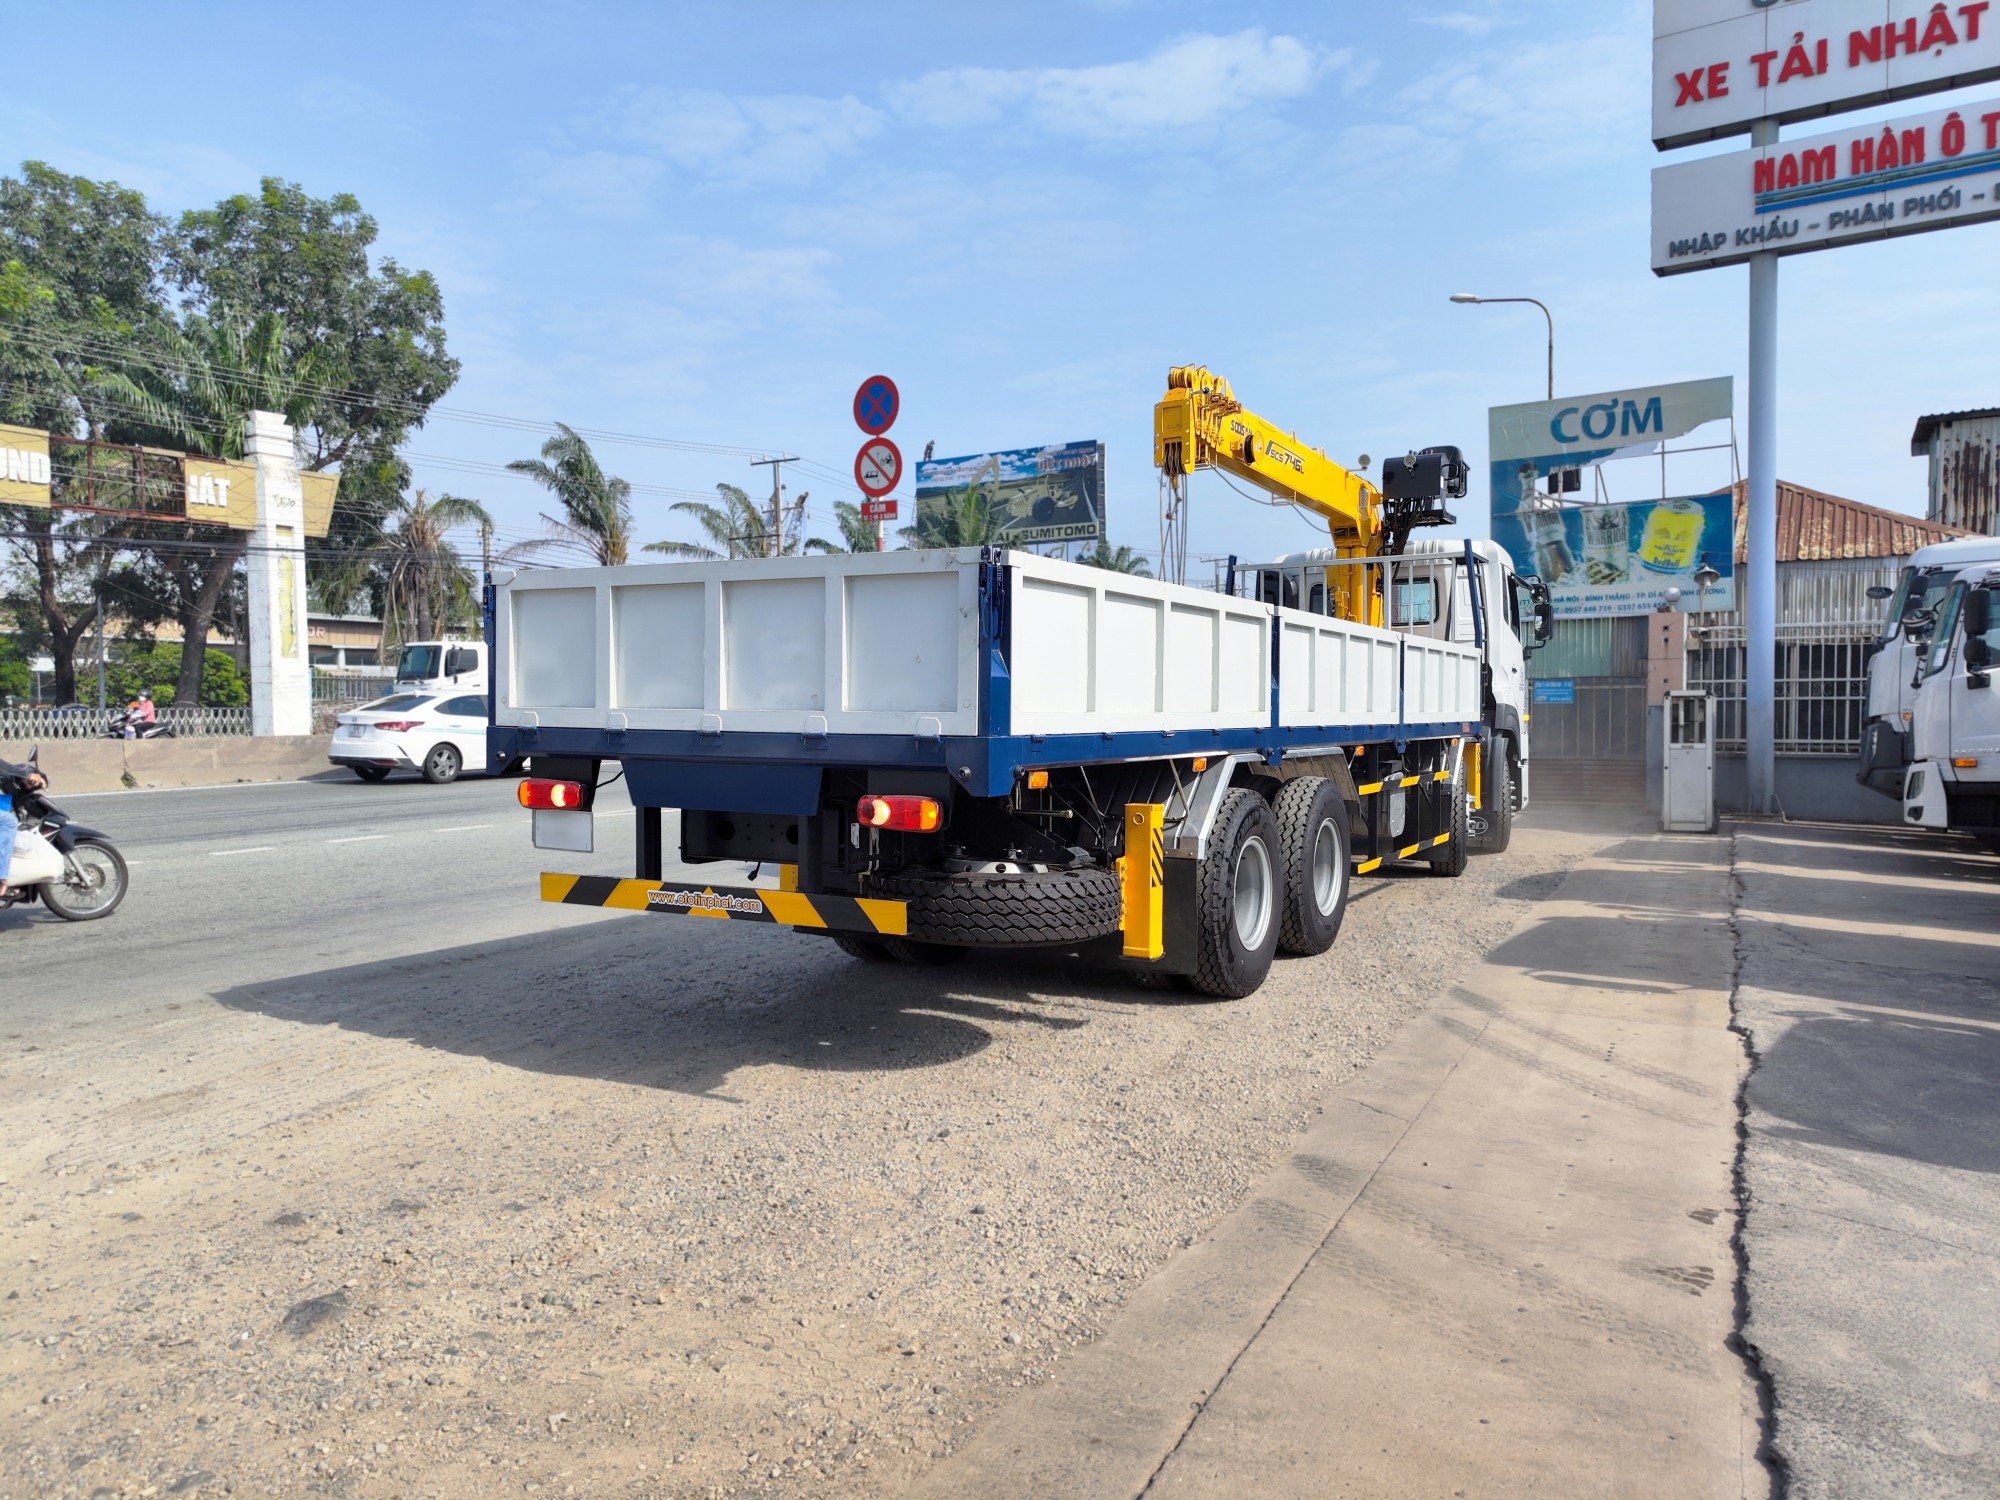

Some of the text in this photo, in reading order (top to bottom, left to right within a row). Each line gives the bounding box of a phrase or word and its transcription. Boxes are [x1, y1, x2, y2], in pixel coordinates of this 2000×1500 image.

[1675, 2, 1989, 107] XE TẢI NHẬT
[1754, 144, 1836, 194] NAM
[1851, 126, 1925, 175] HÀN
[1940, 112, 1966, 157] Ô
[1668, 231, 1727, 258] NHẬP
[1735, 214, 1799, 247] KHẨU
[1829, 201, 1895, 230] PHÂN
[1904, 185, 1962, 217] PHỐI
[1551, 397, 1663, 444] CƠM
[1021, 524, 1096, 540] SUMITOMO
[1680, 588, 1694, 596] ÌNH
[648, 891, 761, 913] www.ototinphat.com
